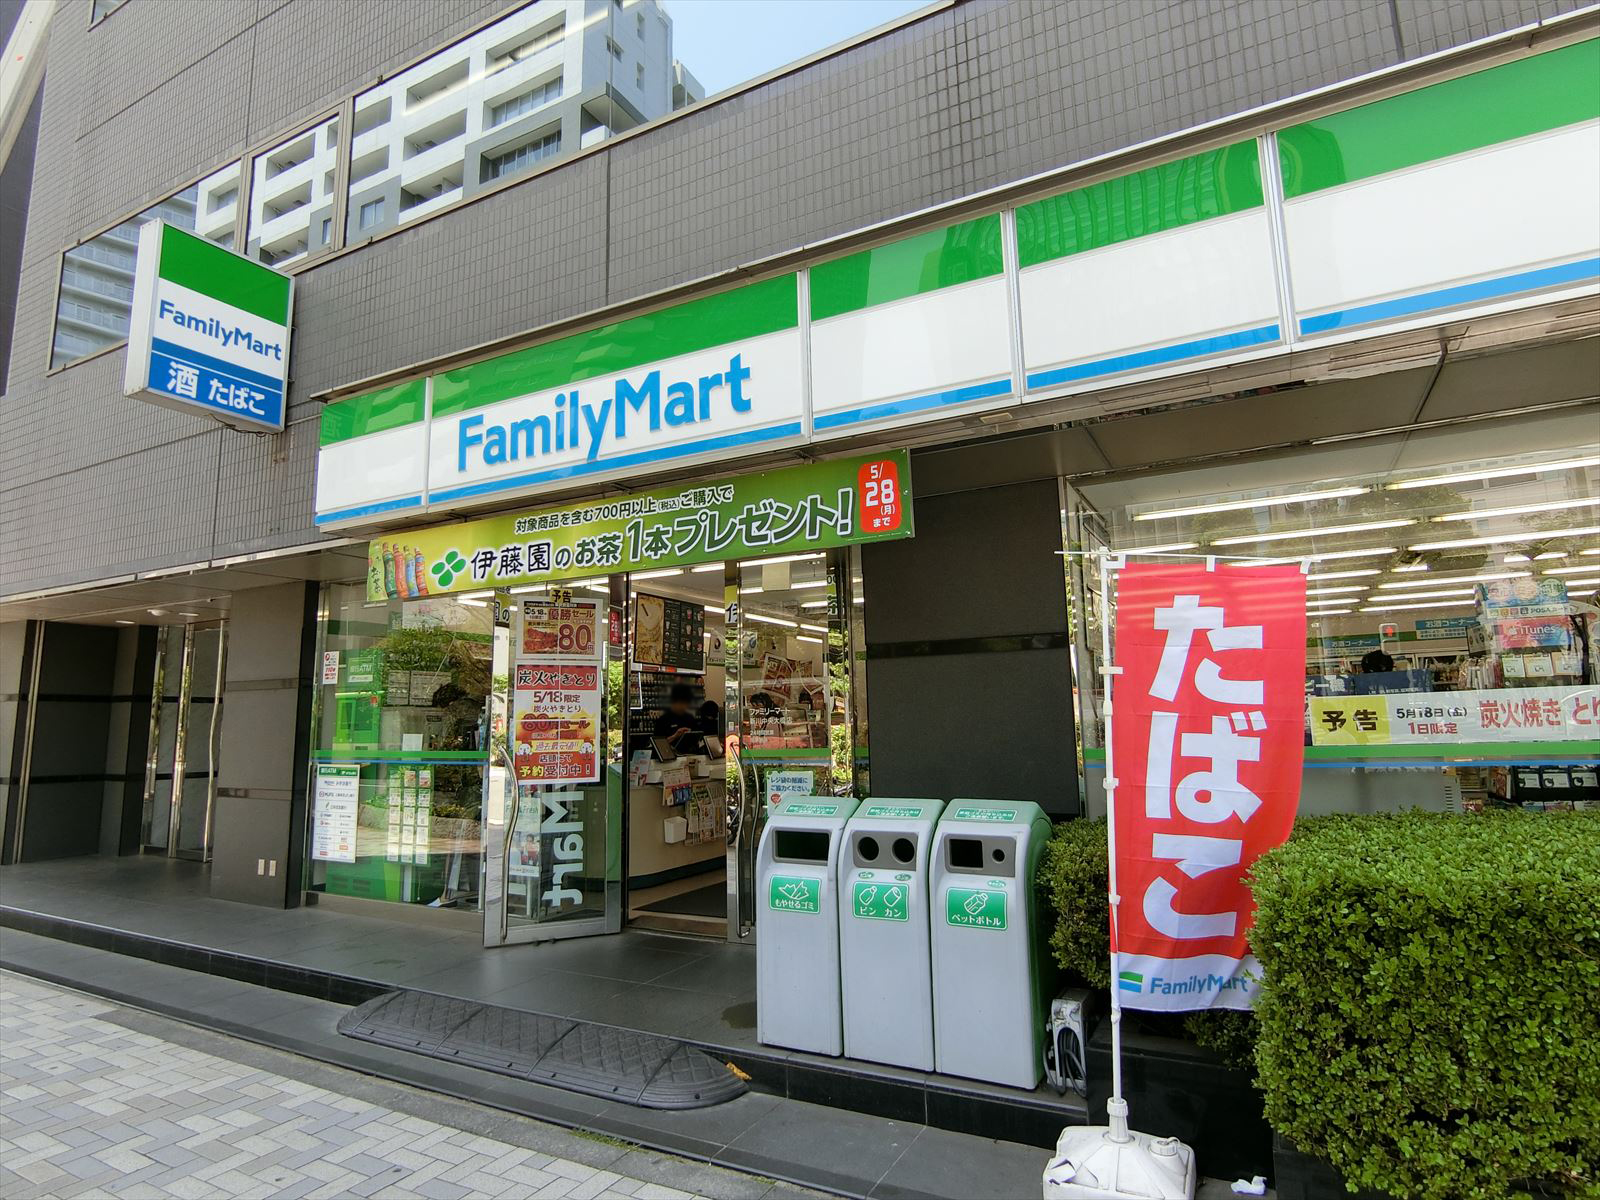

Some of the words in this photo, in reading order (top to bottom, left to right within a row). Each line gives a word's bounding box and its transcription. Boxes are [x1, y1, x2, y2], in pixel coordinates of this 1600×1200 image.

[159, 299, 282, 361] FamilyMart
[167, 361, 199, 399] 酒
[208, 378, 265, 415] たばこ
[458, 352, 752, 473] FamilyMart
[873, 516, 890, 528] まで
[552, 589, 572, 603] 予告
[1520, 625, 1557, 635] iTunes
[518, 669, 597, 686] 炭火やきとり
[749, 707, 791, 716] ファミリーマート
[1322, 709, 1378, 732] 予告
[1408, 722, 1458, 735] 1日限定
[1143, 594, 1268, 940] たばこ
[775, 898, 814, 910] もやせるゴミ
[884, 908, 902, 918] カン
[951, 914, 1002, 926] ペットボトル
[1150, 973, 1248, 995] FamilyMart
